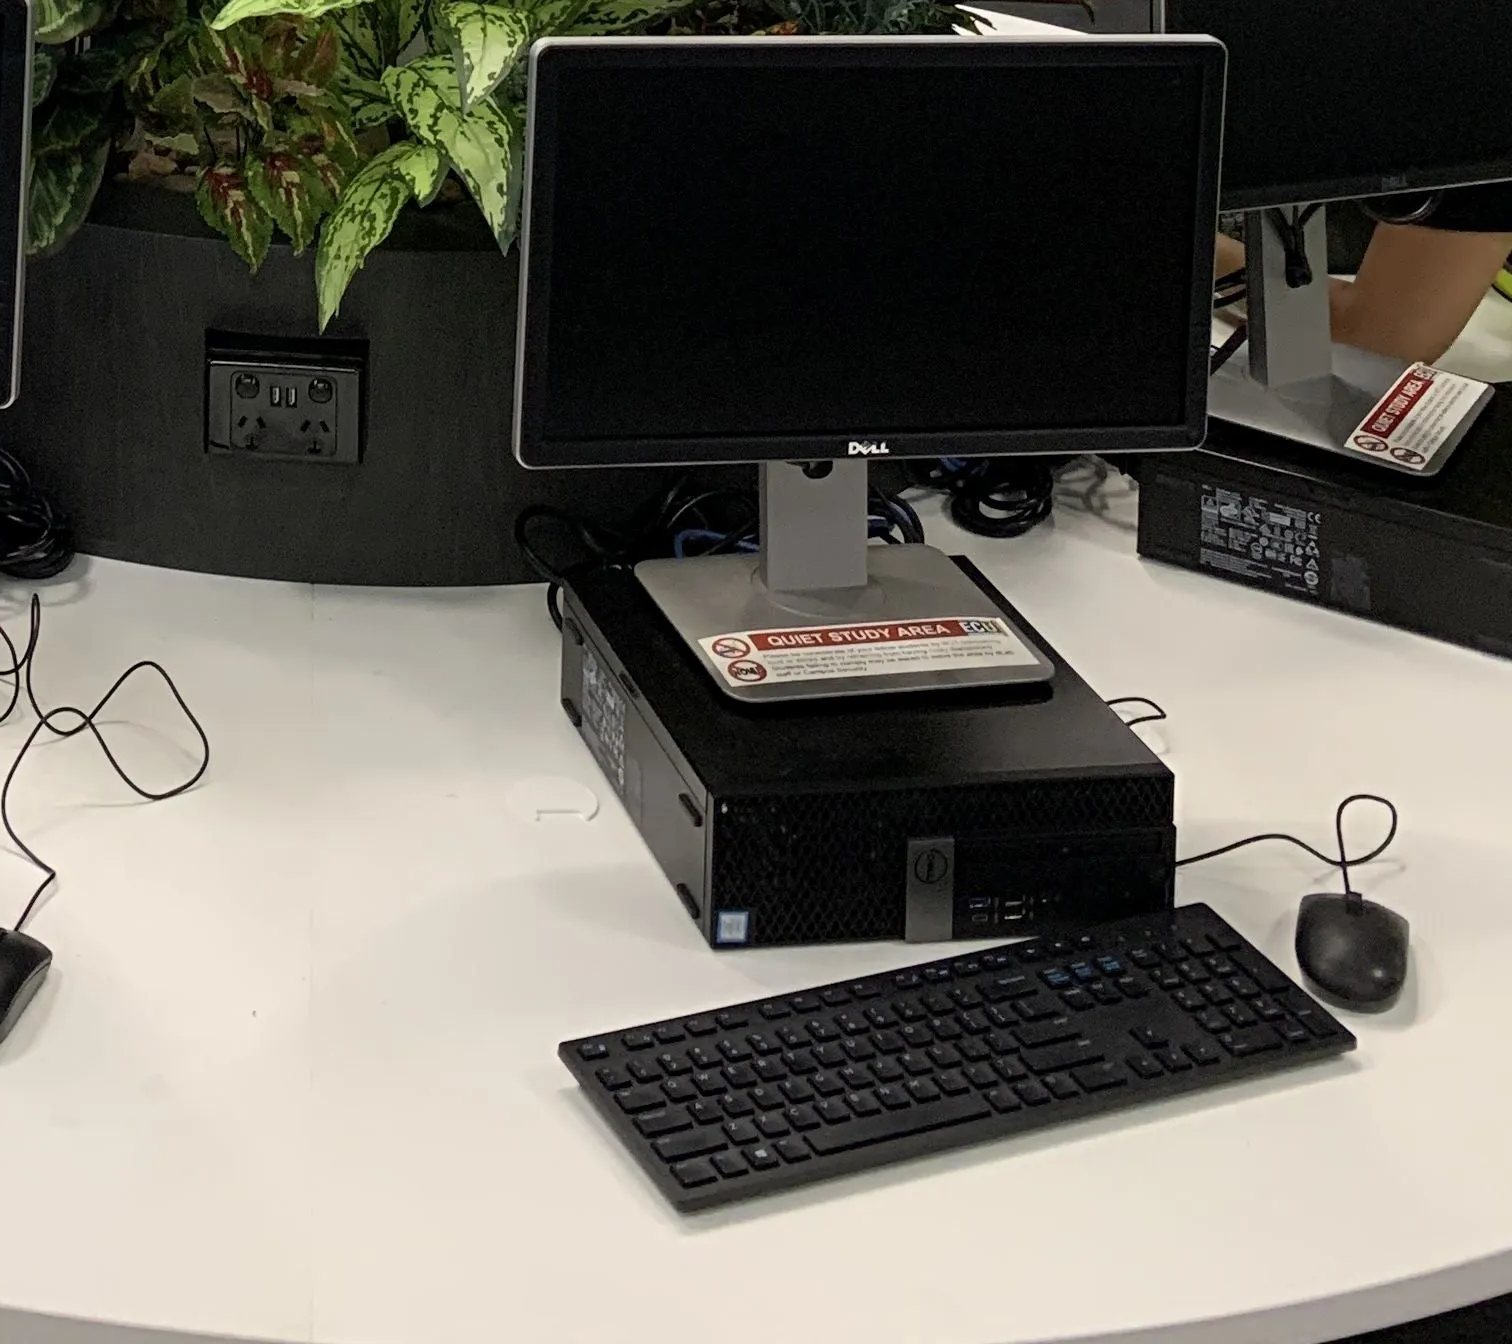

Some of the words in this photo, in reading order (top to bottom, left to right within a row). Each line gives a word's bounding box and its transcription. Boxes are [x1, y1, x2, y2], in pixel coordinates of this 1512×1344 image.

[848, 441, 890, 455] DELL
[767, 633, 824, 646] QUIET
[828, 628, 890, 642] STUDY
[898, 624, 950, 638] AREA
